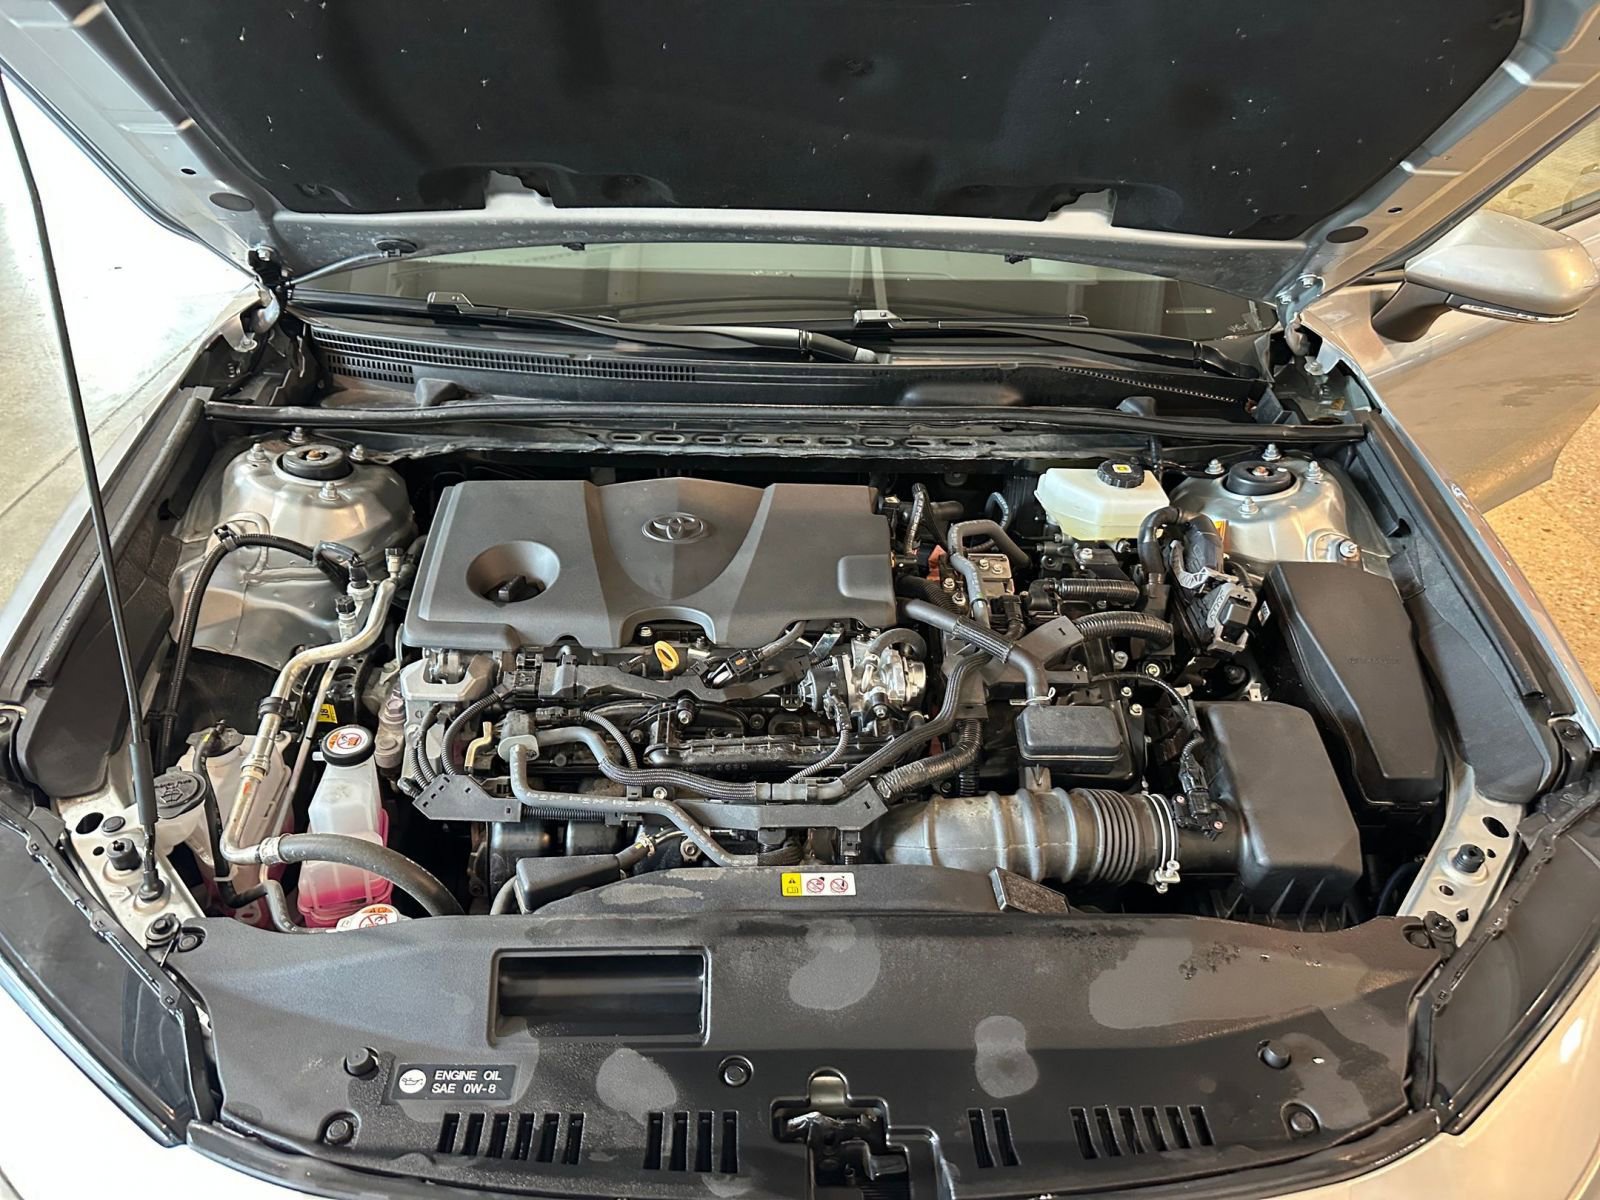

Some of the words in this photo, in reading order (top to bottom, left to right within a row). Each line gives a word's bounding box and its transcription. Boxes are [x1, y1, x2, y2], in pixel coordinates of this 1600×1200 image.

[434, 1070, 478, 1081] ENGINE
[483, 1070, 502, 1081] OIL
[431, 1083, 457, 1094] SAE
[463, 1083, 497, 1094] 0W-8
